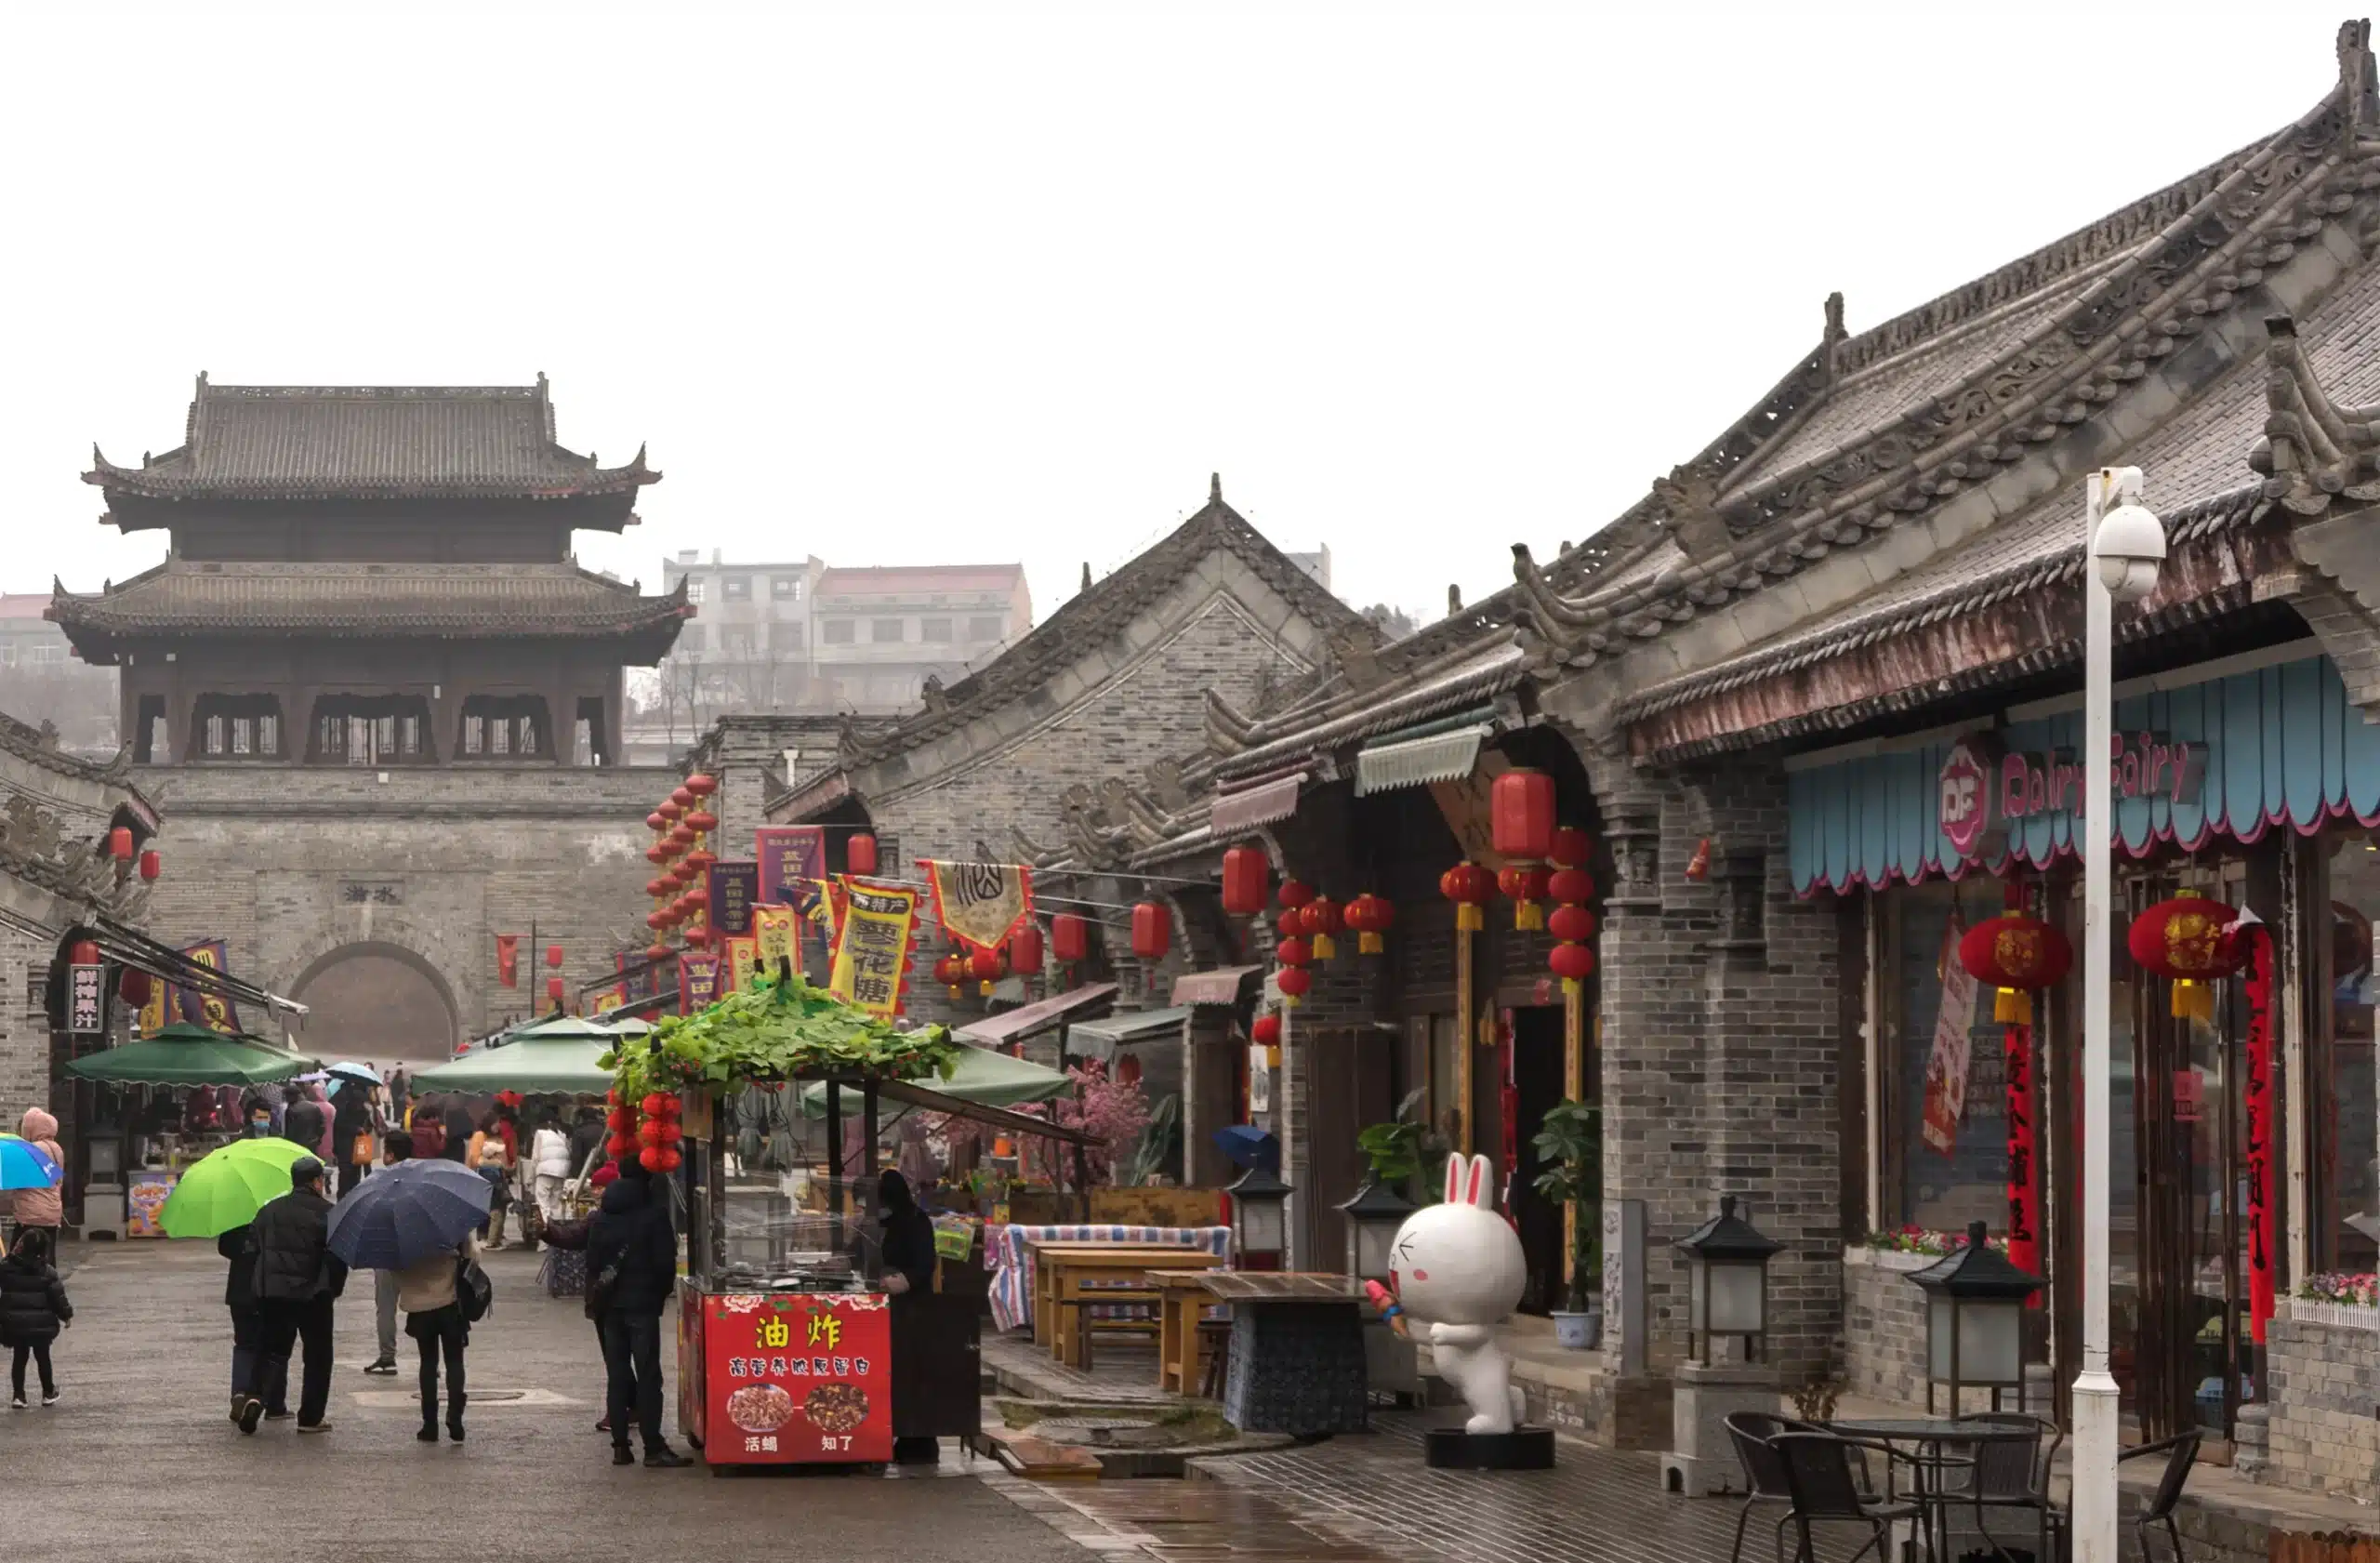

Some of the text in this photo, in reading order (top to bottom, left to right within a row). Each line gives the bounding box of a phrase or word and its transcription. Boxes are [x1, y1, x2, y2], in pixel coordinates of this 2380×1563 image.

[755, 1314, 842, 1350] 油炸
[745, 1436, 778, 1452] 活蝎
[821, 1436, 853, 1451] 知了
